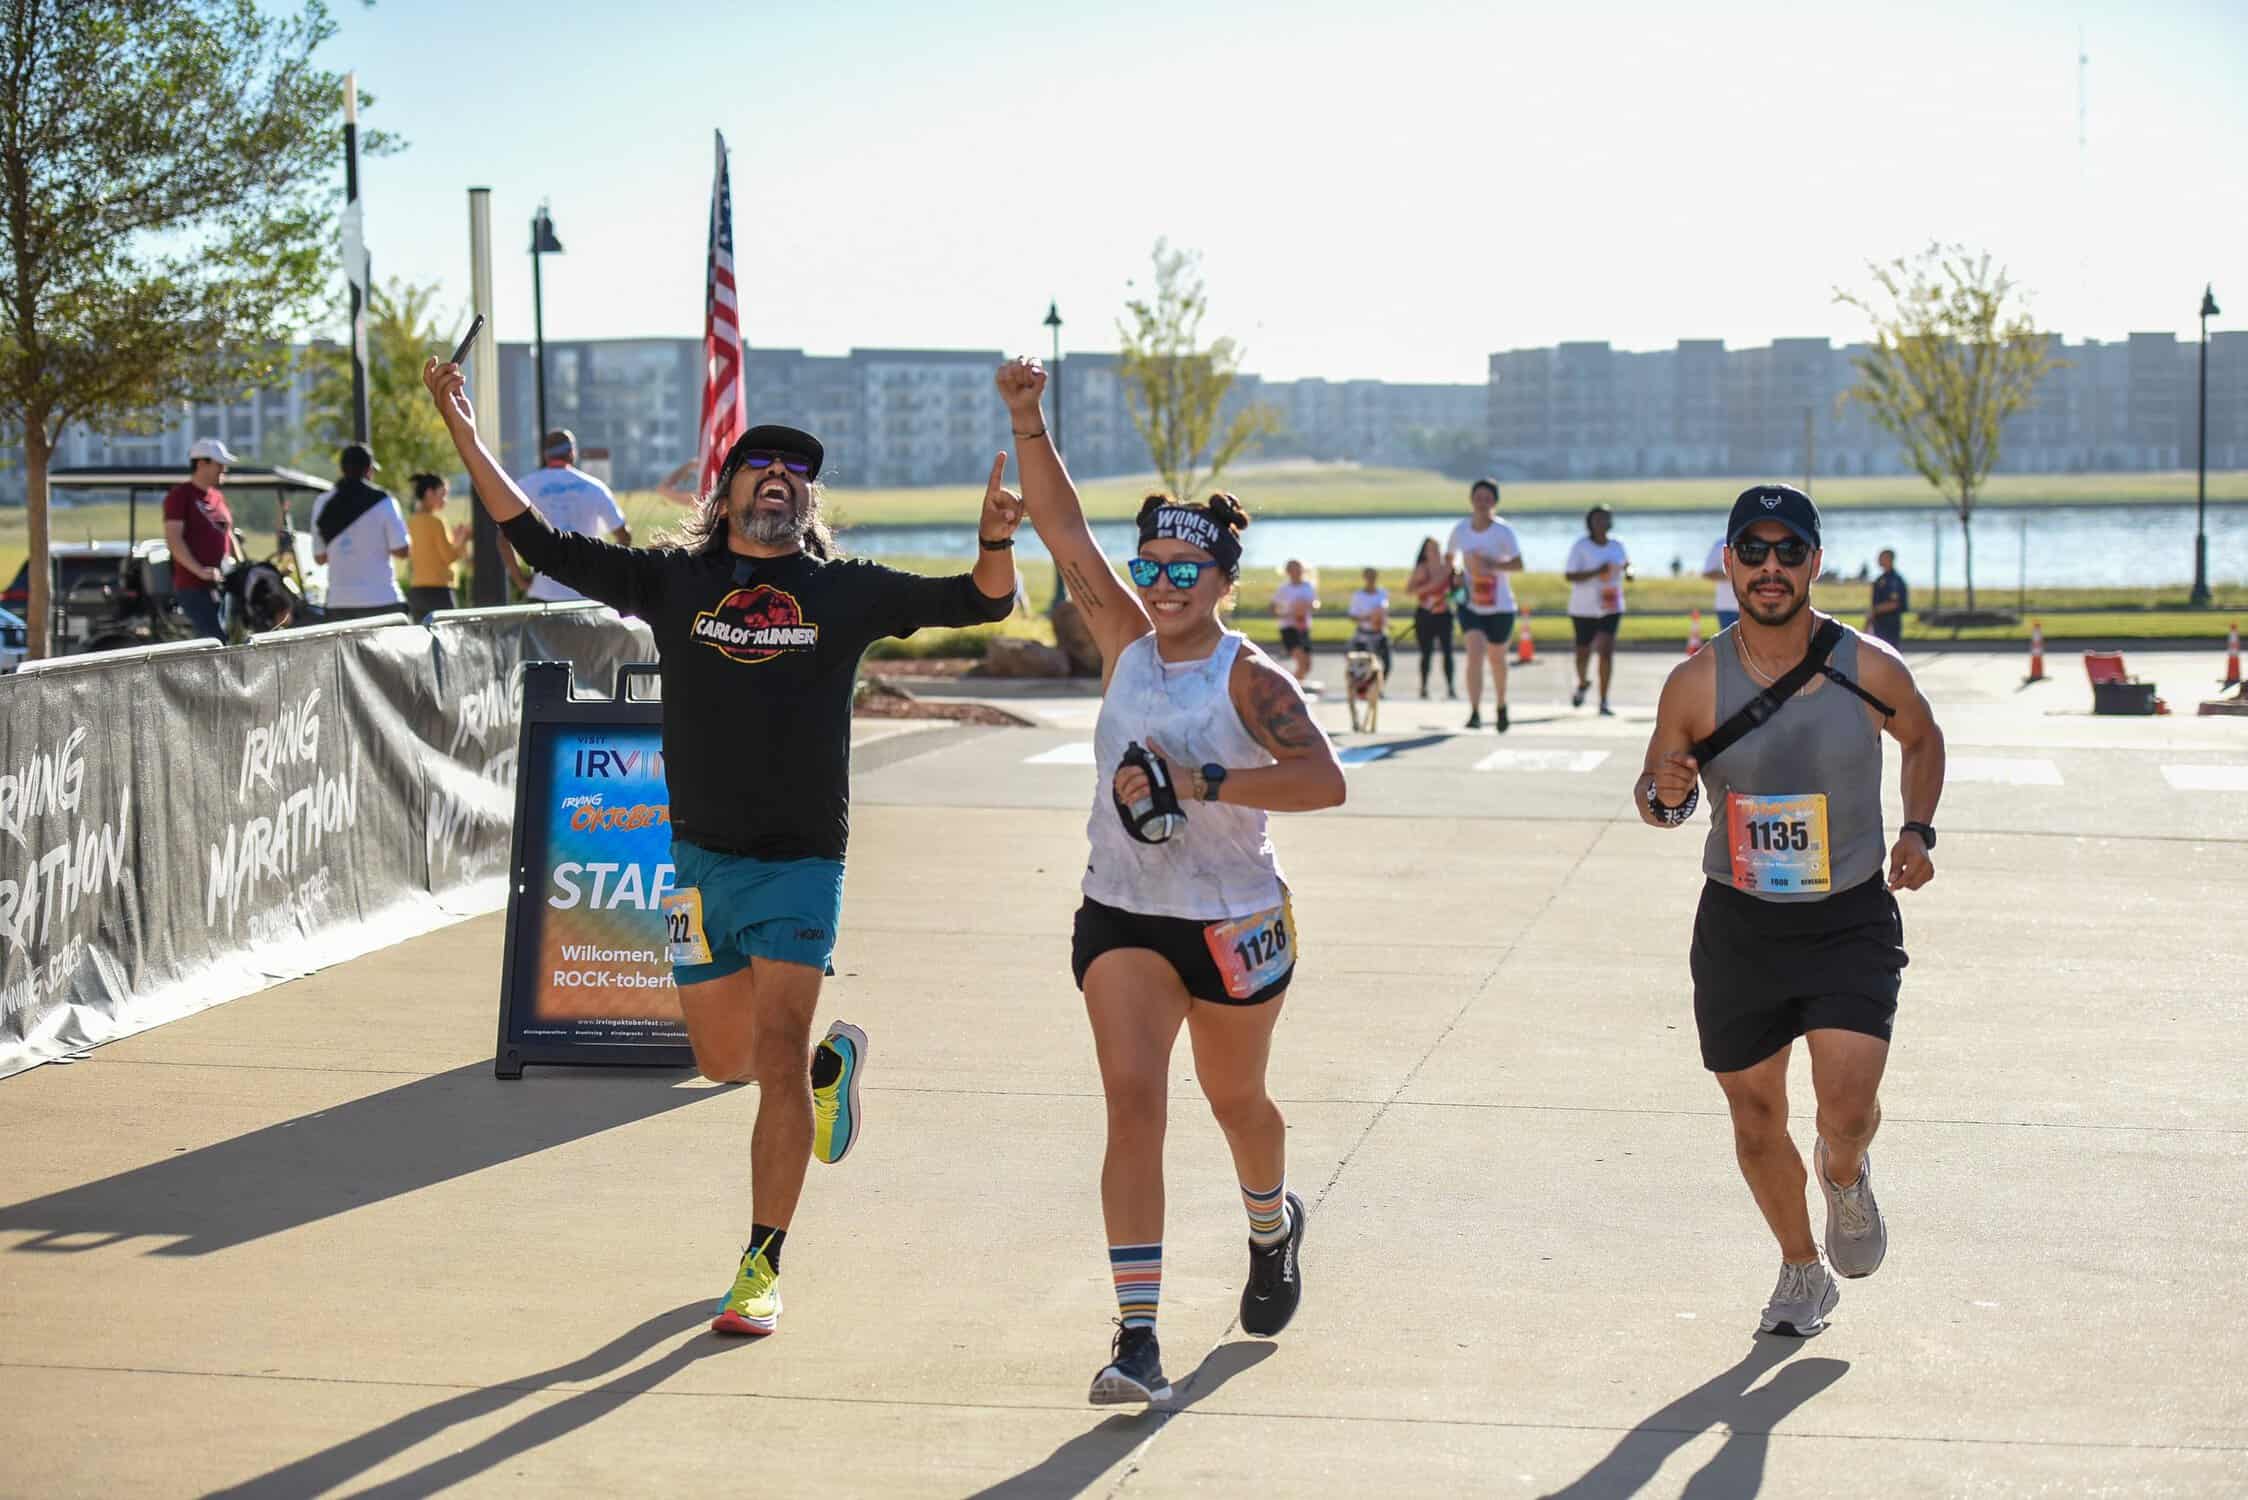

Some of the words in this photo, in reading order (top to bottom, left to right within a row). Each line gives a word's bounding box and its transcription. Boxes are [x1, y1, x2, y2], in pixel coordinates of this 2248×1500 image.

[1157, 510, 1219, 542] WOMEN
[240, 688, 321, 804] IRVING
[577, 735, 607, 745] VISIT
[561, 793, 604, 809] IRVING
[208, 741, 359, 937] MARATHON
[1746, 820, 1809, 851] 1135
[561, 945, 659, 965] Wilkomen,
[1234, 919, 1286, 972] 1128
